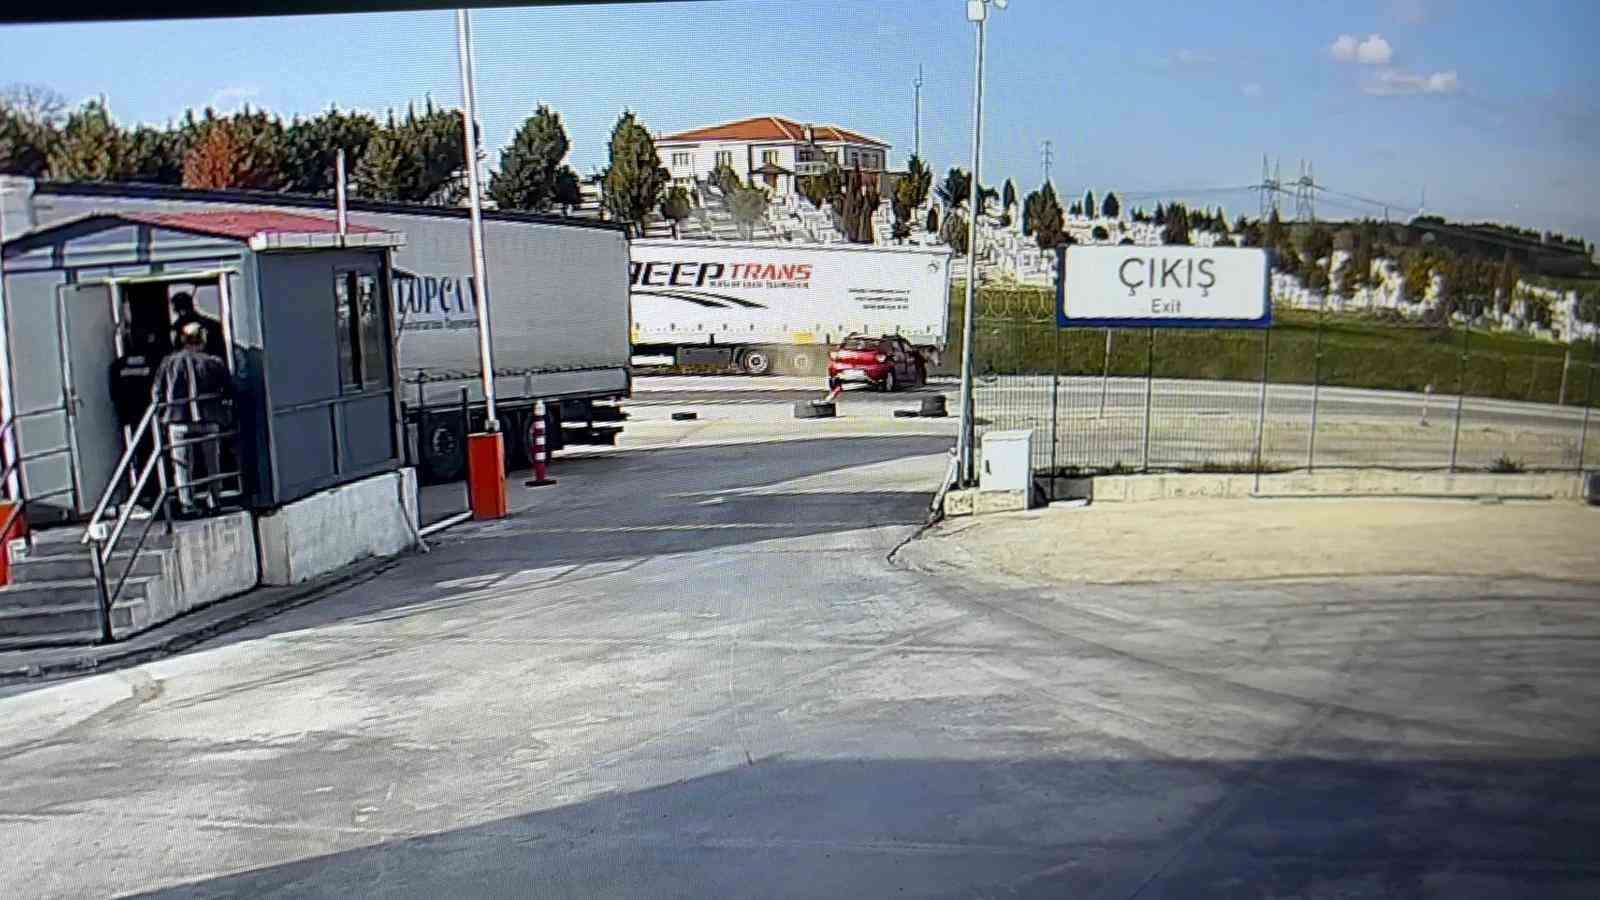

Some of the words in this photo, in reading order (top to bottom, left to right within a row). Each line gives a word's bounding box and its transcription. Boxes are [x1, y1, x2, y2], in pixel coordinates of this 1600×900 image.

[730, 263, 813, 281] TRANS
[1119, 257, 1216, 297] ÇIKIŞ
[1151, 299, 1182, 314] Exit
